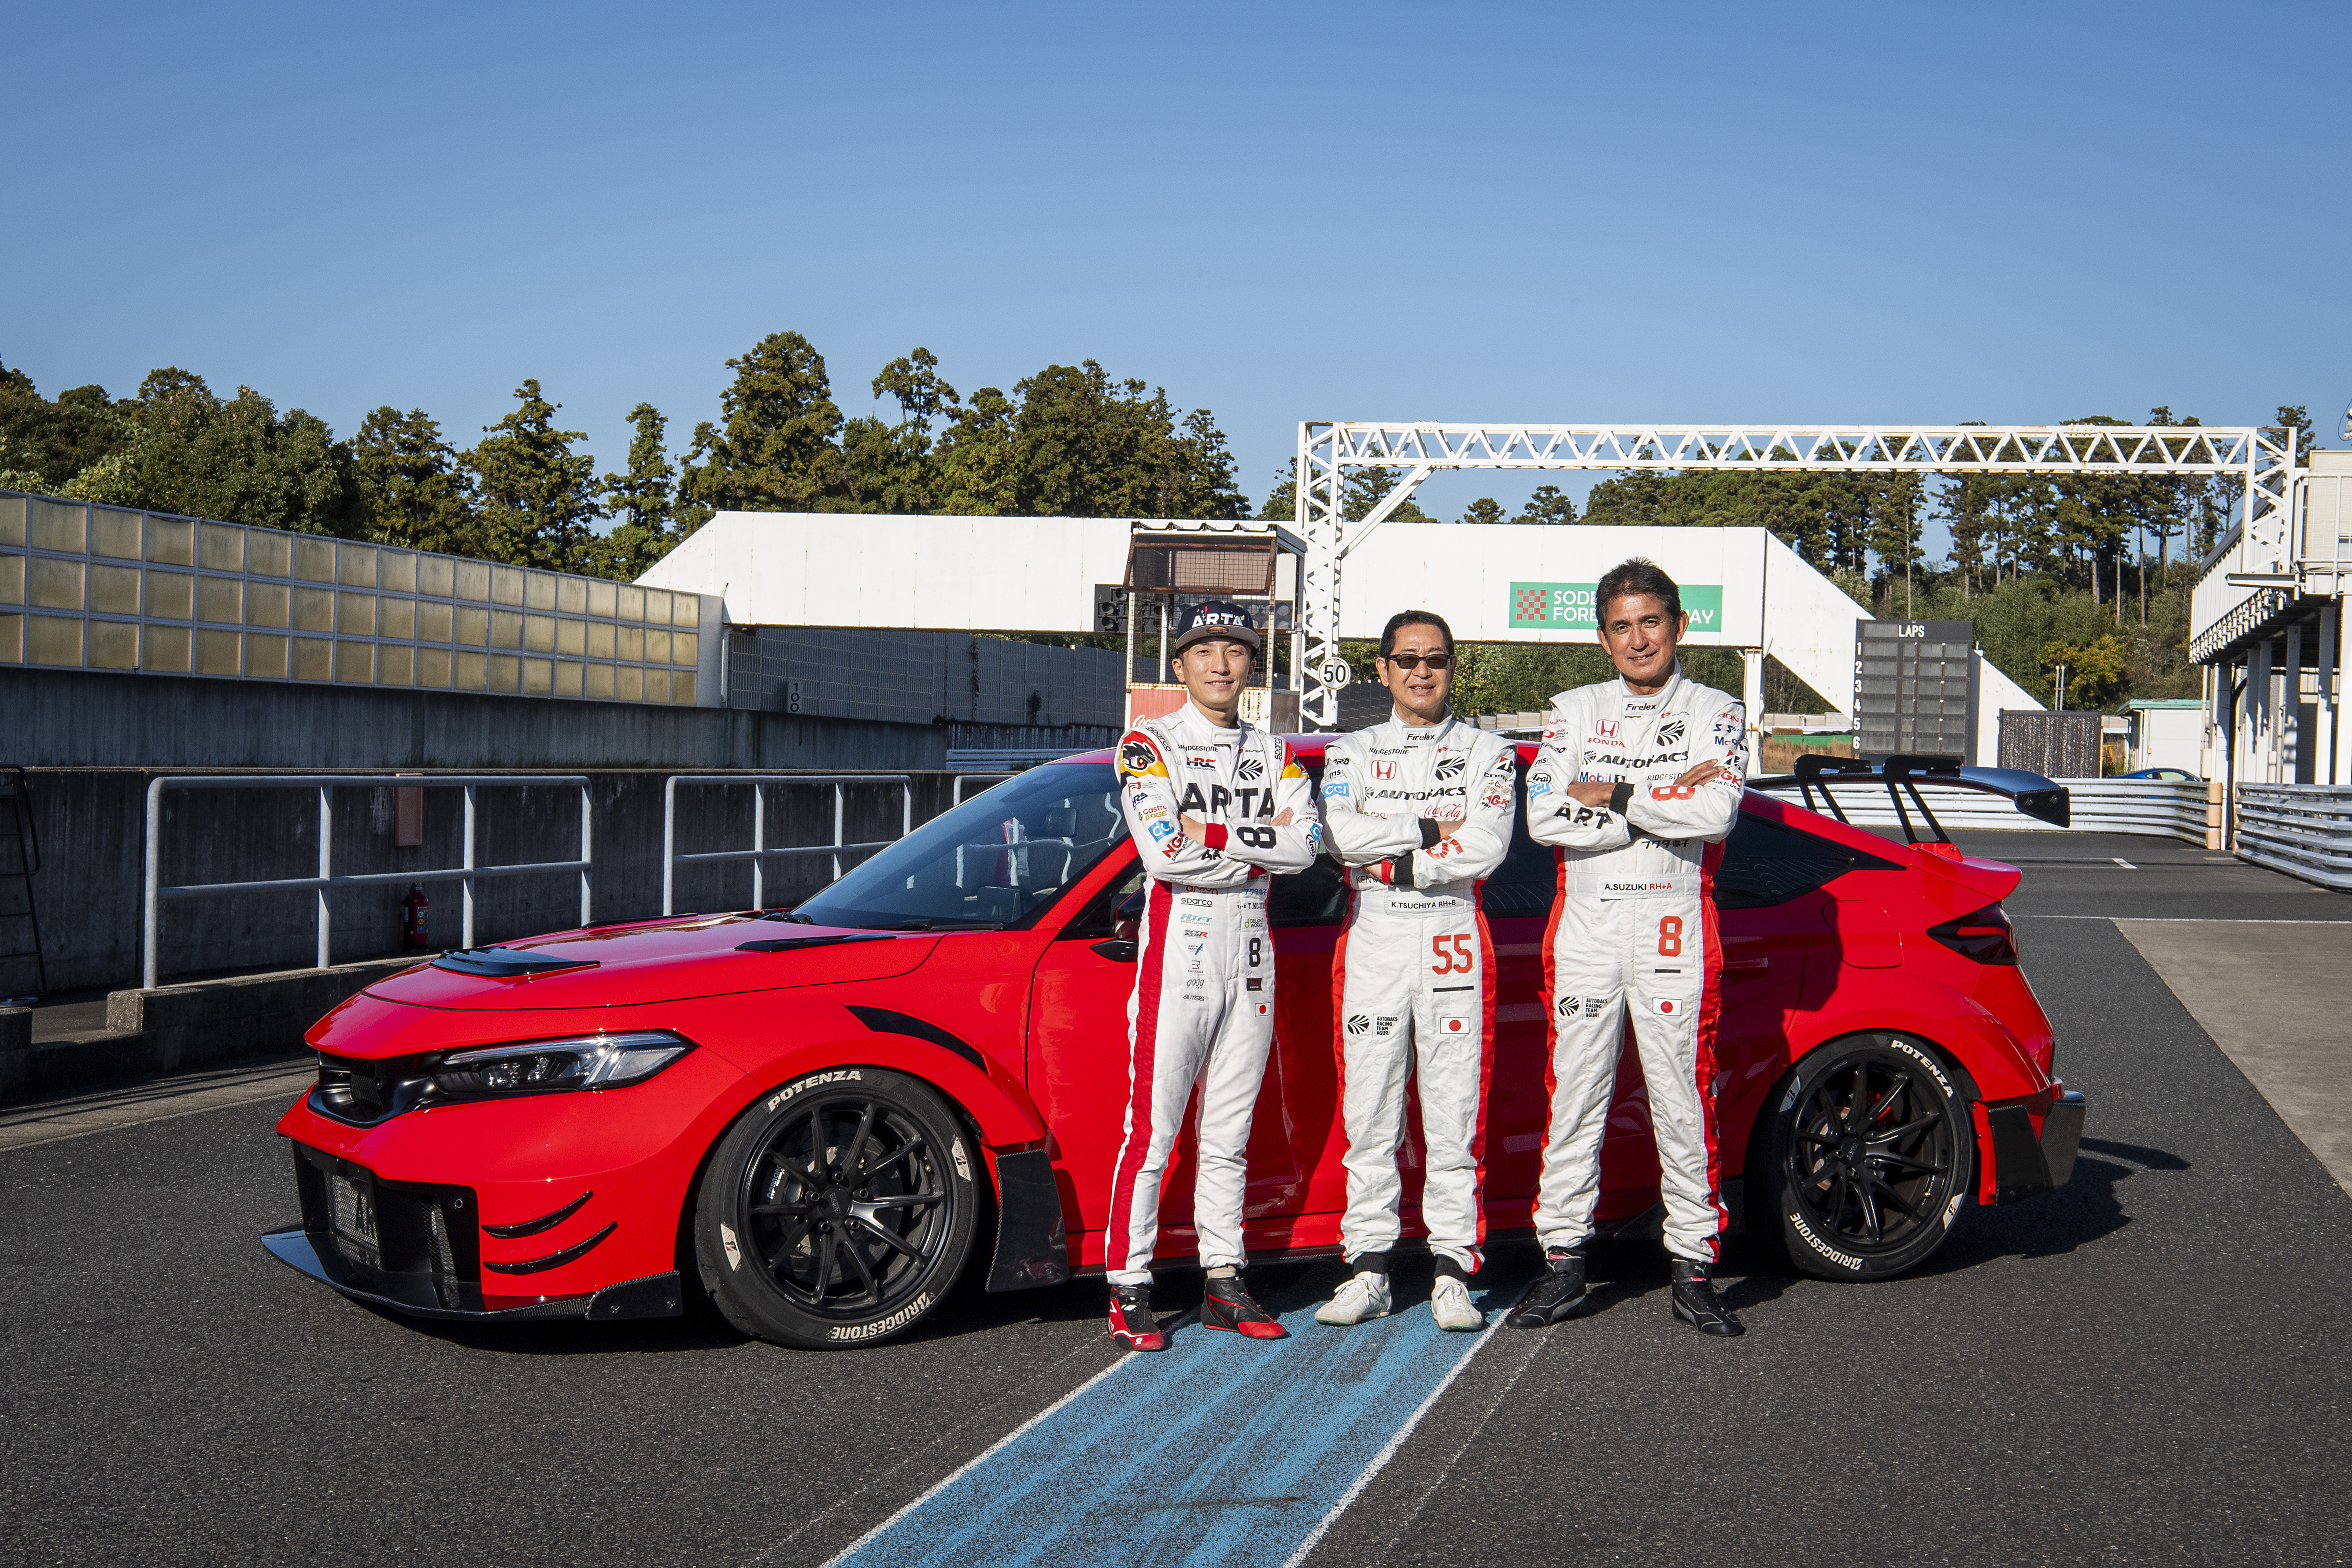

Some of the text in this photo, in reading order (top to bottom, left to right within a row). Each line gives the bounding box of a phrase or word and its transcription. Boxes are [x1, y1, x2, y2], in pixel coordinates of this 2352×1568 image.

[1553, 590, 1596, 605] SODE
[1192, 613, 1243, 628] ARTA
[1553, 607, 1714, 624] FORE AY
[1899, 625, 1924, 637] LAPS
[1857, 642, 1862, 655] 1
[1324, 665, 1346, 683] 50
[1856, 661, 1862, 674] 2
[1855, 680, 1862, 692] 3
[790, 683, 799, 712] 100
[1854, 699, 1861, 711] 4
[1853, 717, 1860, 730] 5
[1146, 727, 1171, 751] sparco
[1587, 737, 1626, 748] HONDA
[1715, 736, 1737, 746] Mob
[1853, 736, 1860, 749] 6
[1186, 757, 1216, 769] HRC
[1579, 772, 1612, 783] Mobil
[1720, 770, 1742, 787] GK
[1179, 783, 1276, 819] ARTA
[1652, 785, 1696, 802] 8
[1143, 805, 1168, 815] Castro
[1236, 827, 1276, 849] 8
[1181, 898, 1213, 907] sparco
[1658, 916, 1683, 957] 8
[1249, 937, 1261, 967] 8
[1432, 933, 1472, 975] 55
[1891, 1040, 1954, 1098] POTENZA
[767, 1070, 862, 1112] POTENZA
[1790, 1212, 1863, 1270] BRIDGESTONE
[831, 1292, 930, 1339] BRIDGESTONE
